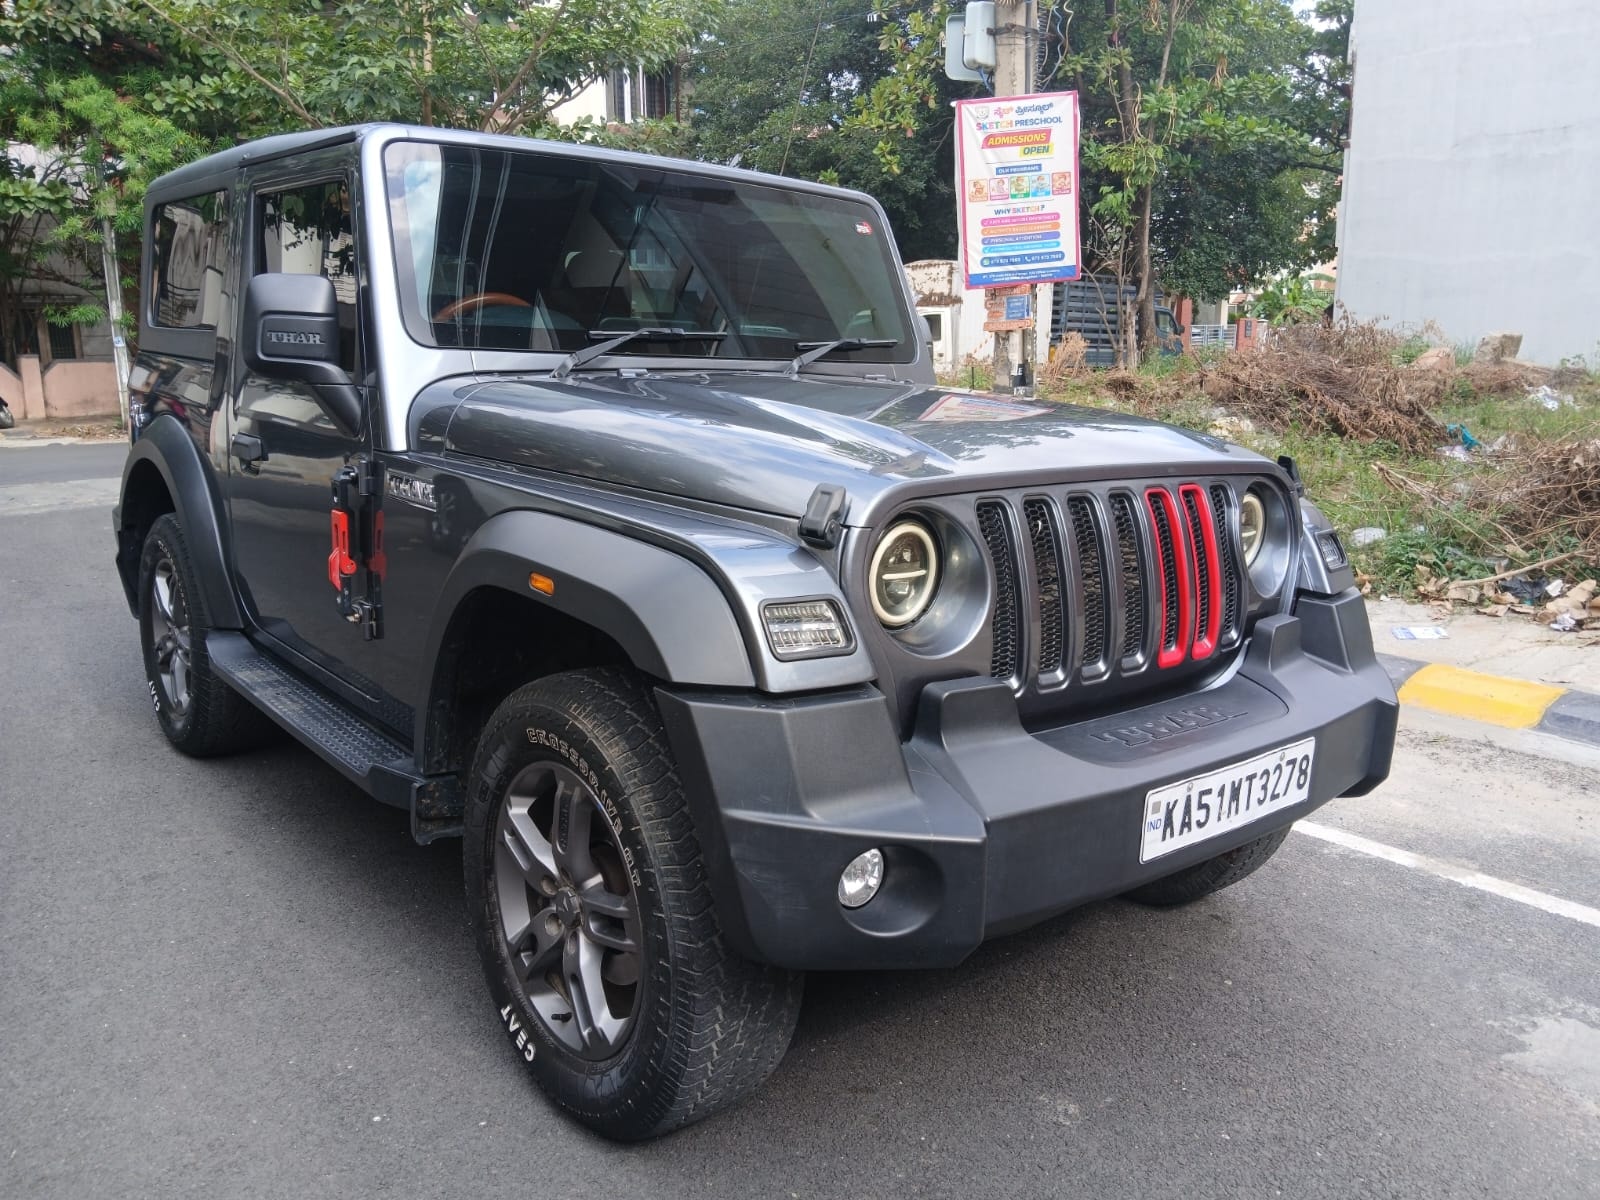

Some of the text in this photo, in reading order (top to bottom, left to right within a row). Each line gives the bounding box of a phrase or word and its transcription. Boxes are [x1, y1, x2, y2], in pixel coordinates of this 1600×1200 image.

[976, 116, 1062, 131] SKETCH PRESCHOOL
[987, 132, 1047, 146] ADMISSIONS
[1023, 145, 1050, 155] OPEN
[994, 207, 1011, 215] WHY
[1012, 206, 1040, 214] SKETCH
[267, 331, 325, 345] THAR
[1146, 753, 1311, 842] IND KA51MT3278
[500, 1004, 536, 1062] CEAT
